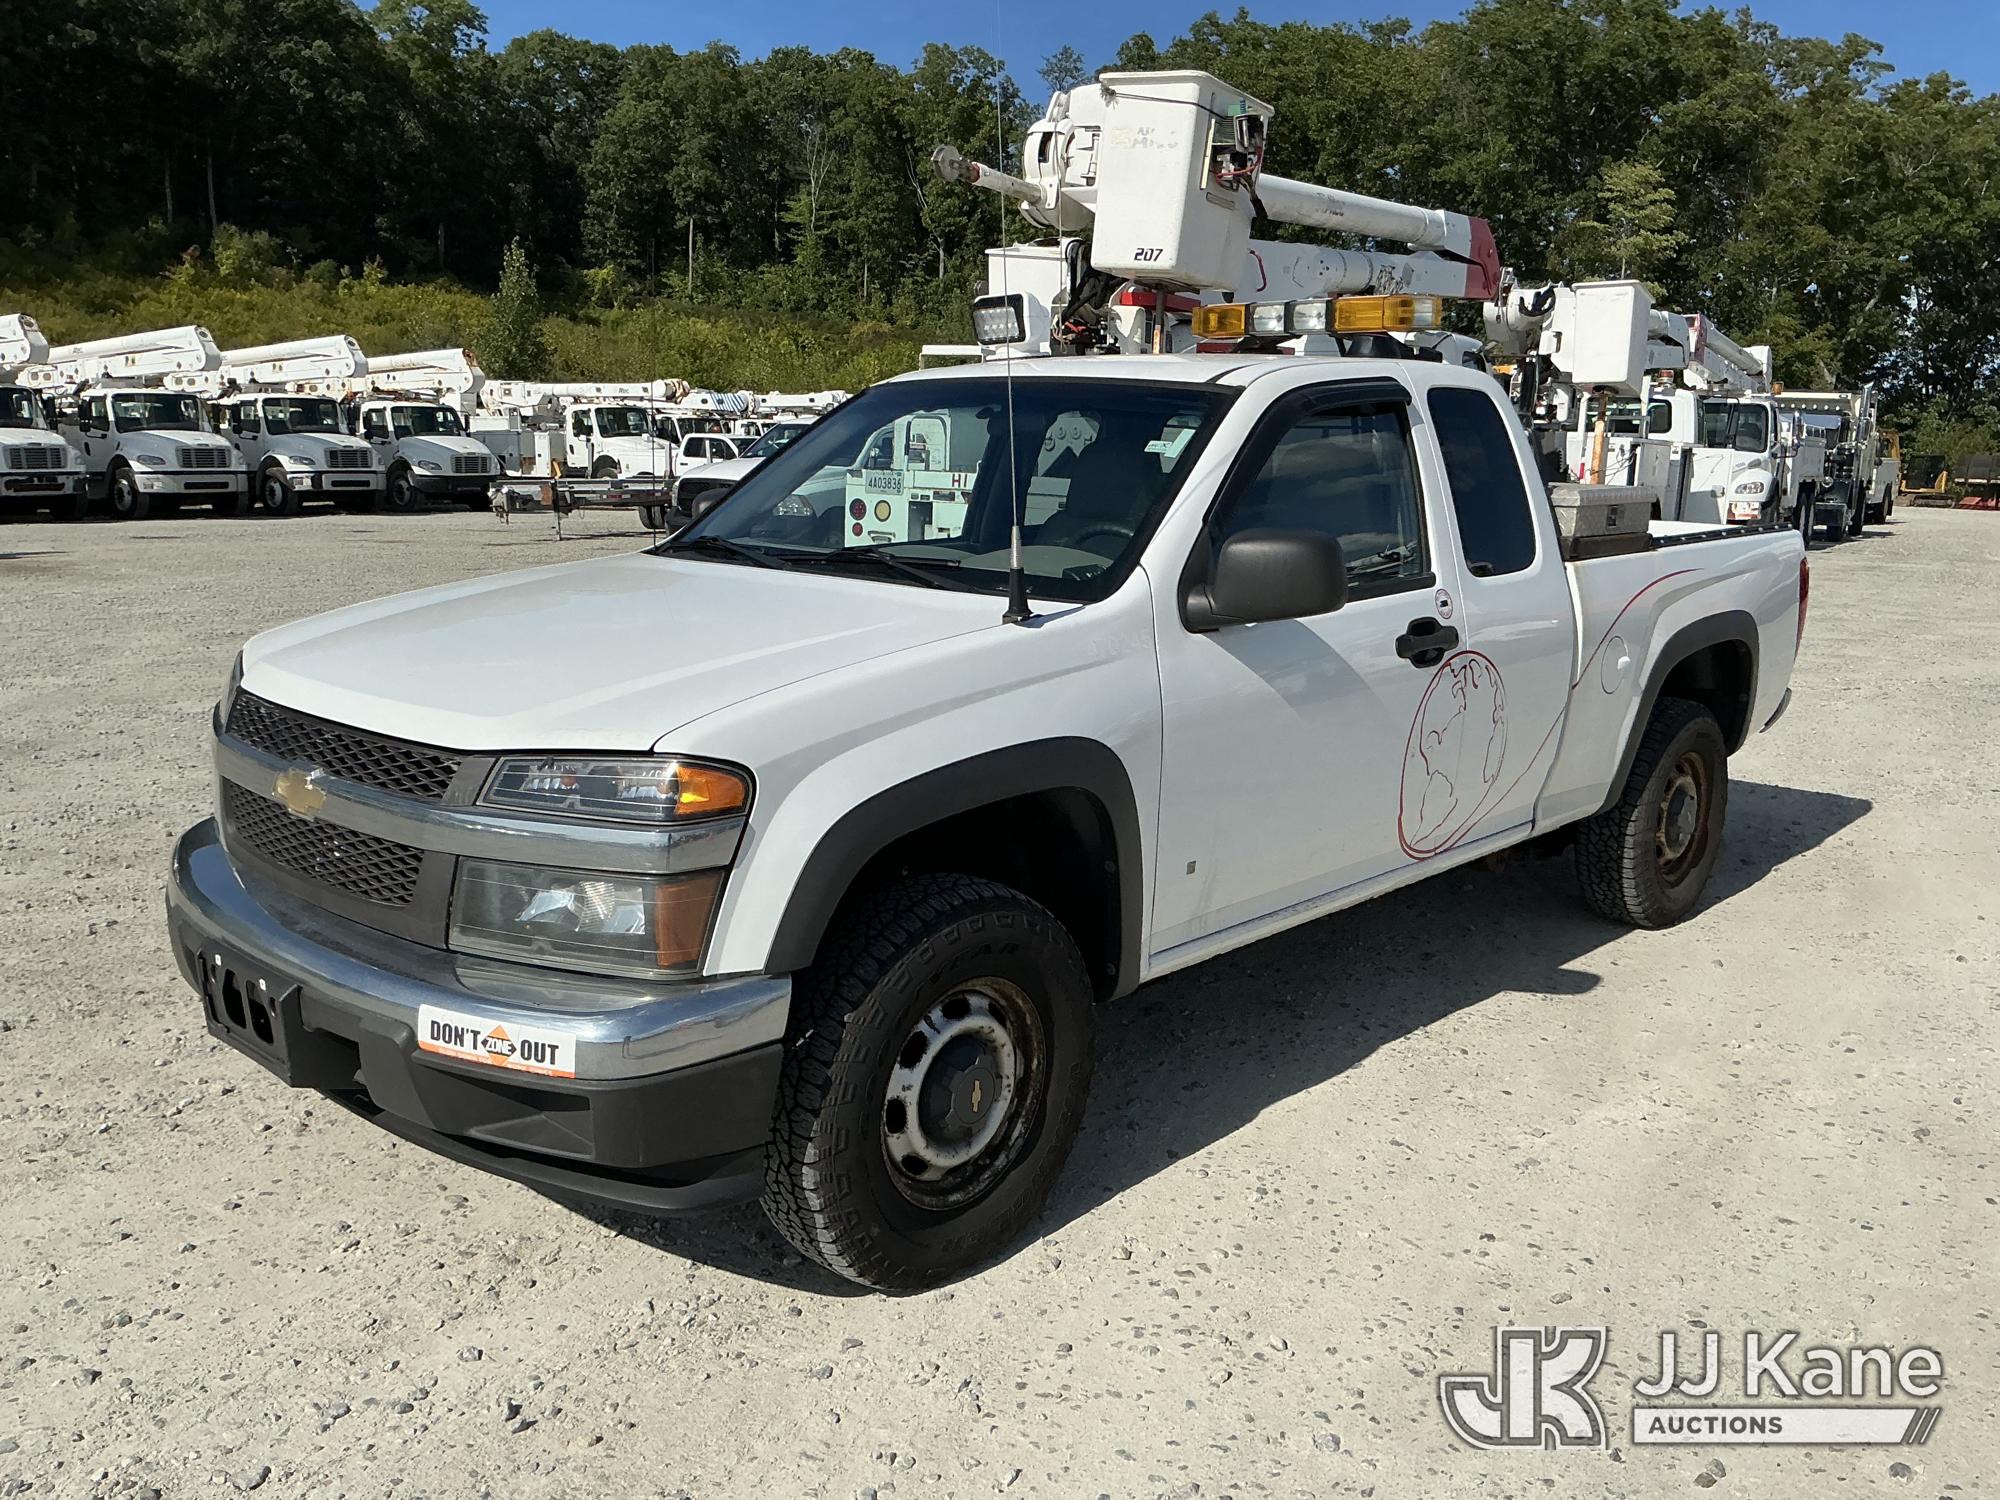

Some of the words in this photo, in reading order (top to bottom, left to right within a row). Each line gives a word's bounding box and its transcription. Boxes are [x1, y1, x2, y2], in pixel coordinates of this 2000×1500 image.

[1134, 248, 1163, 262] 207
[430, 1020, 481, 1051] DON'T
[485, 1037, 512, 1056] ZONE
[520, 1039, 559, 1065] OUT
